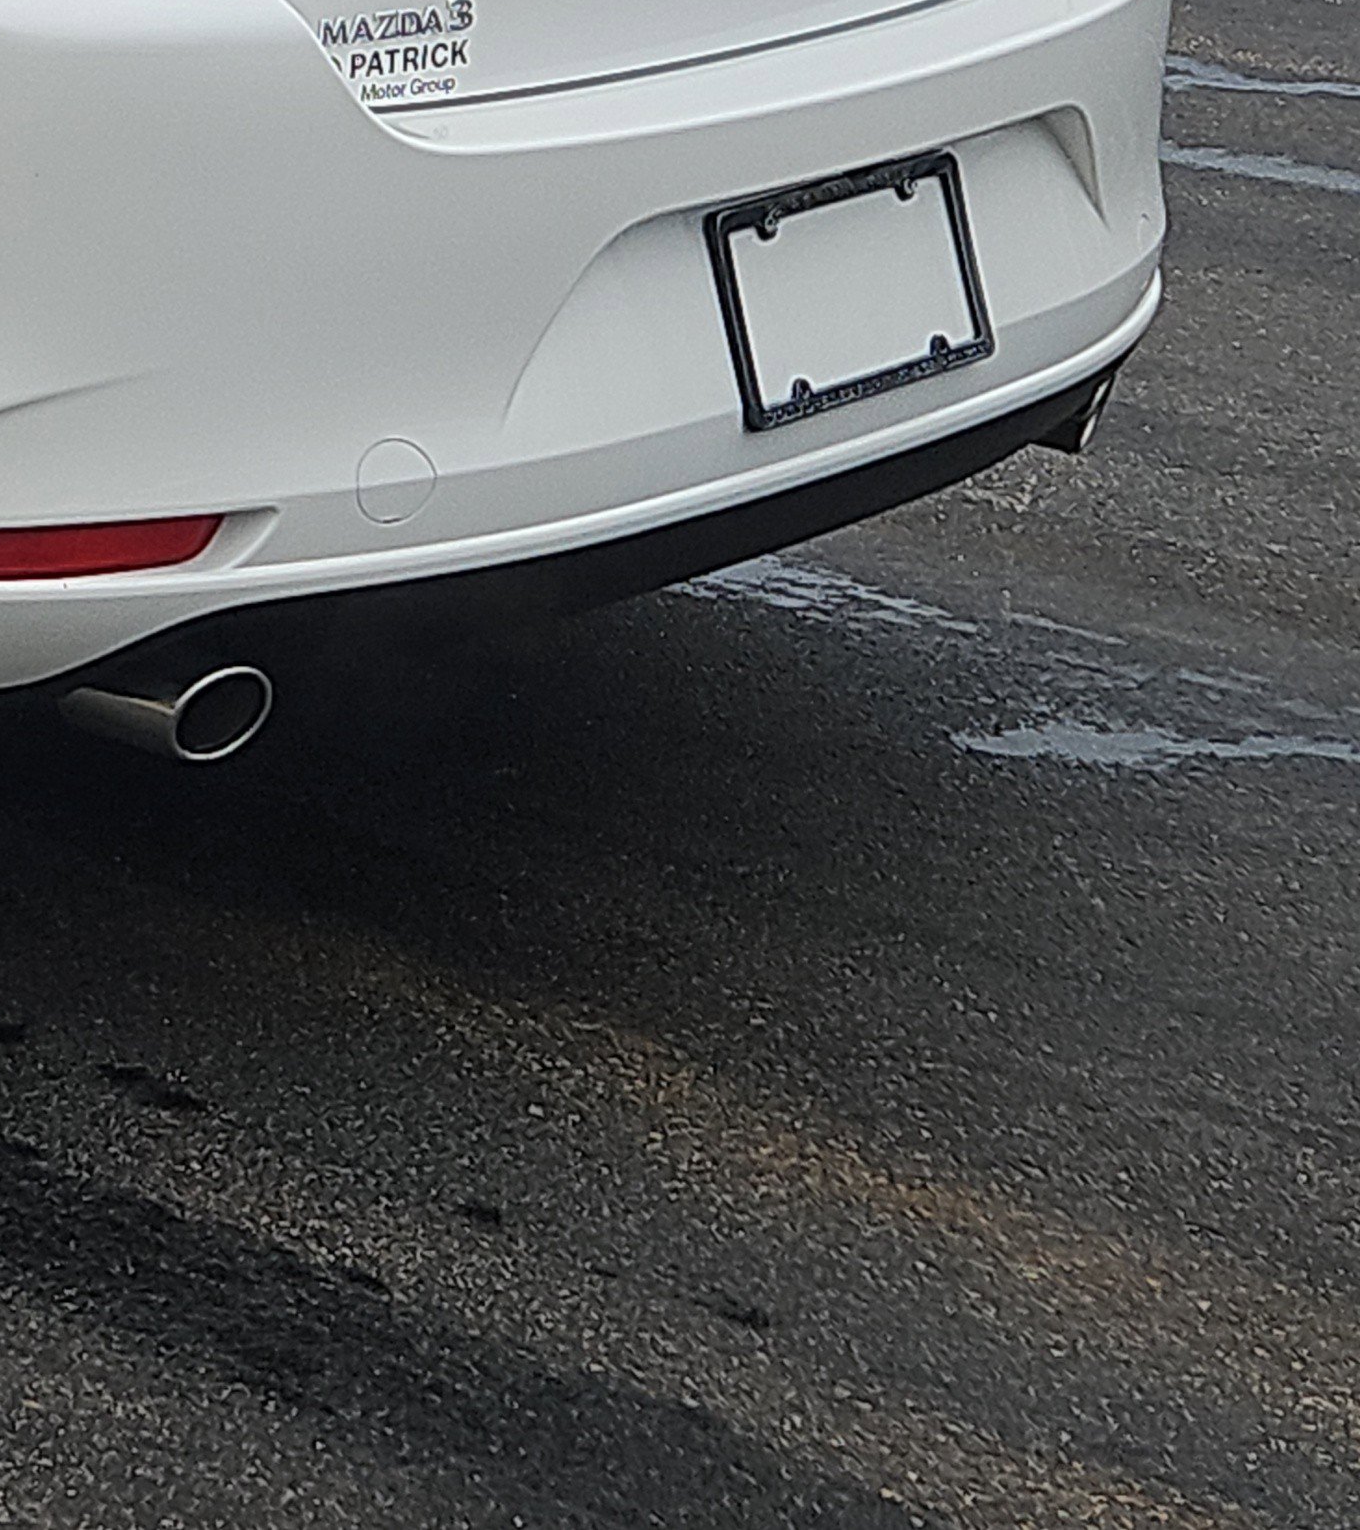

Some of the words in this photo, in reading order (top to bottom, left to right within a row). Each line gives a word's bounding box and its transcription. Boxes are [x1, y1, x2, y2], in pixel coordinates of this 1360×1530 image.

[349, 39, 469, 79] PATRICK
[361, 83, 407, 102] Motor
[410, 78, 456, 95] Group
